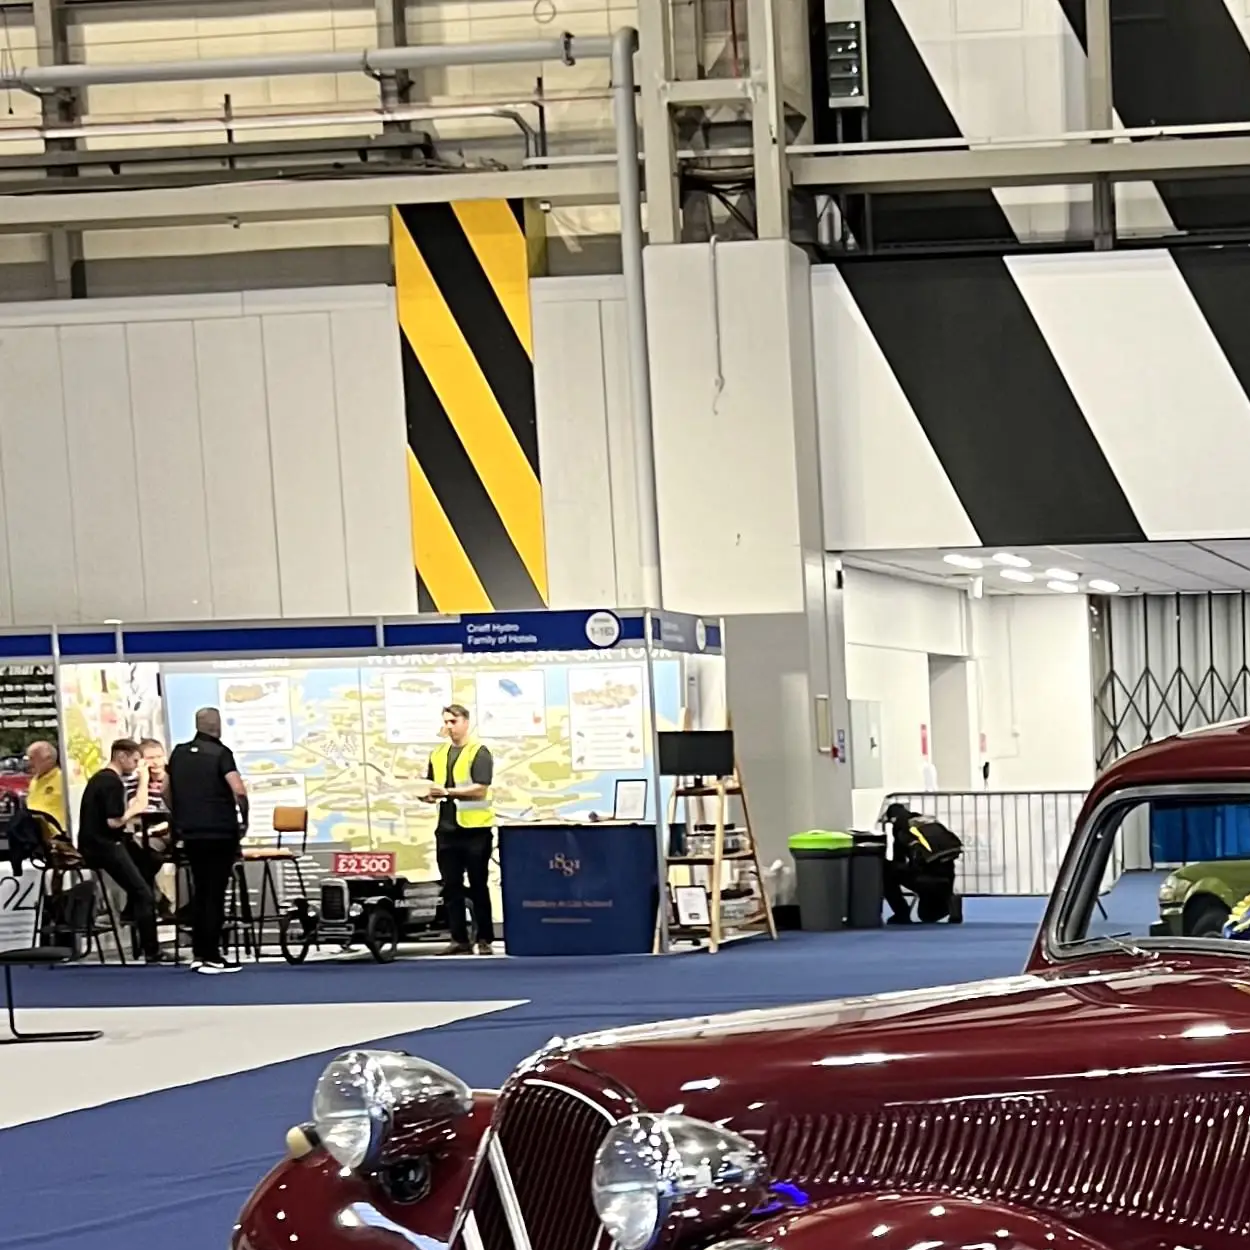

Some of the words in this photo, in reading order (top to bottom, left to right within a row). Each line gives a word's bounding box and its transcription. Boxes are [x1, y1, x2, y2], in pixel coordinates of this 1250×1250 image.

[467, 635, 496, 646] Family
[497, 635, 507, 644] of
[337, 858, 390, 874] £2,500
